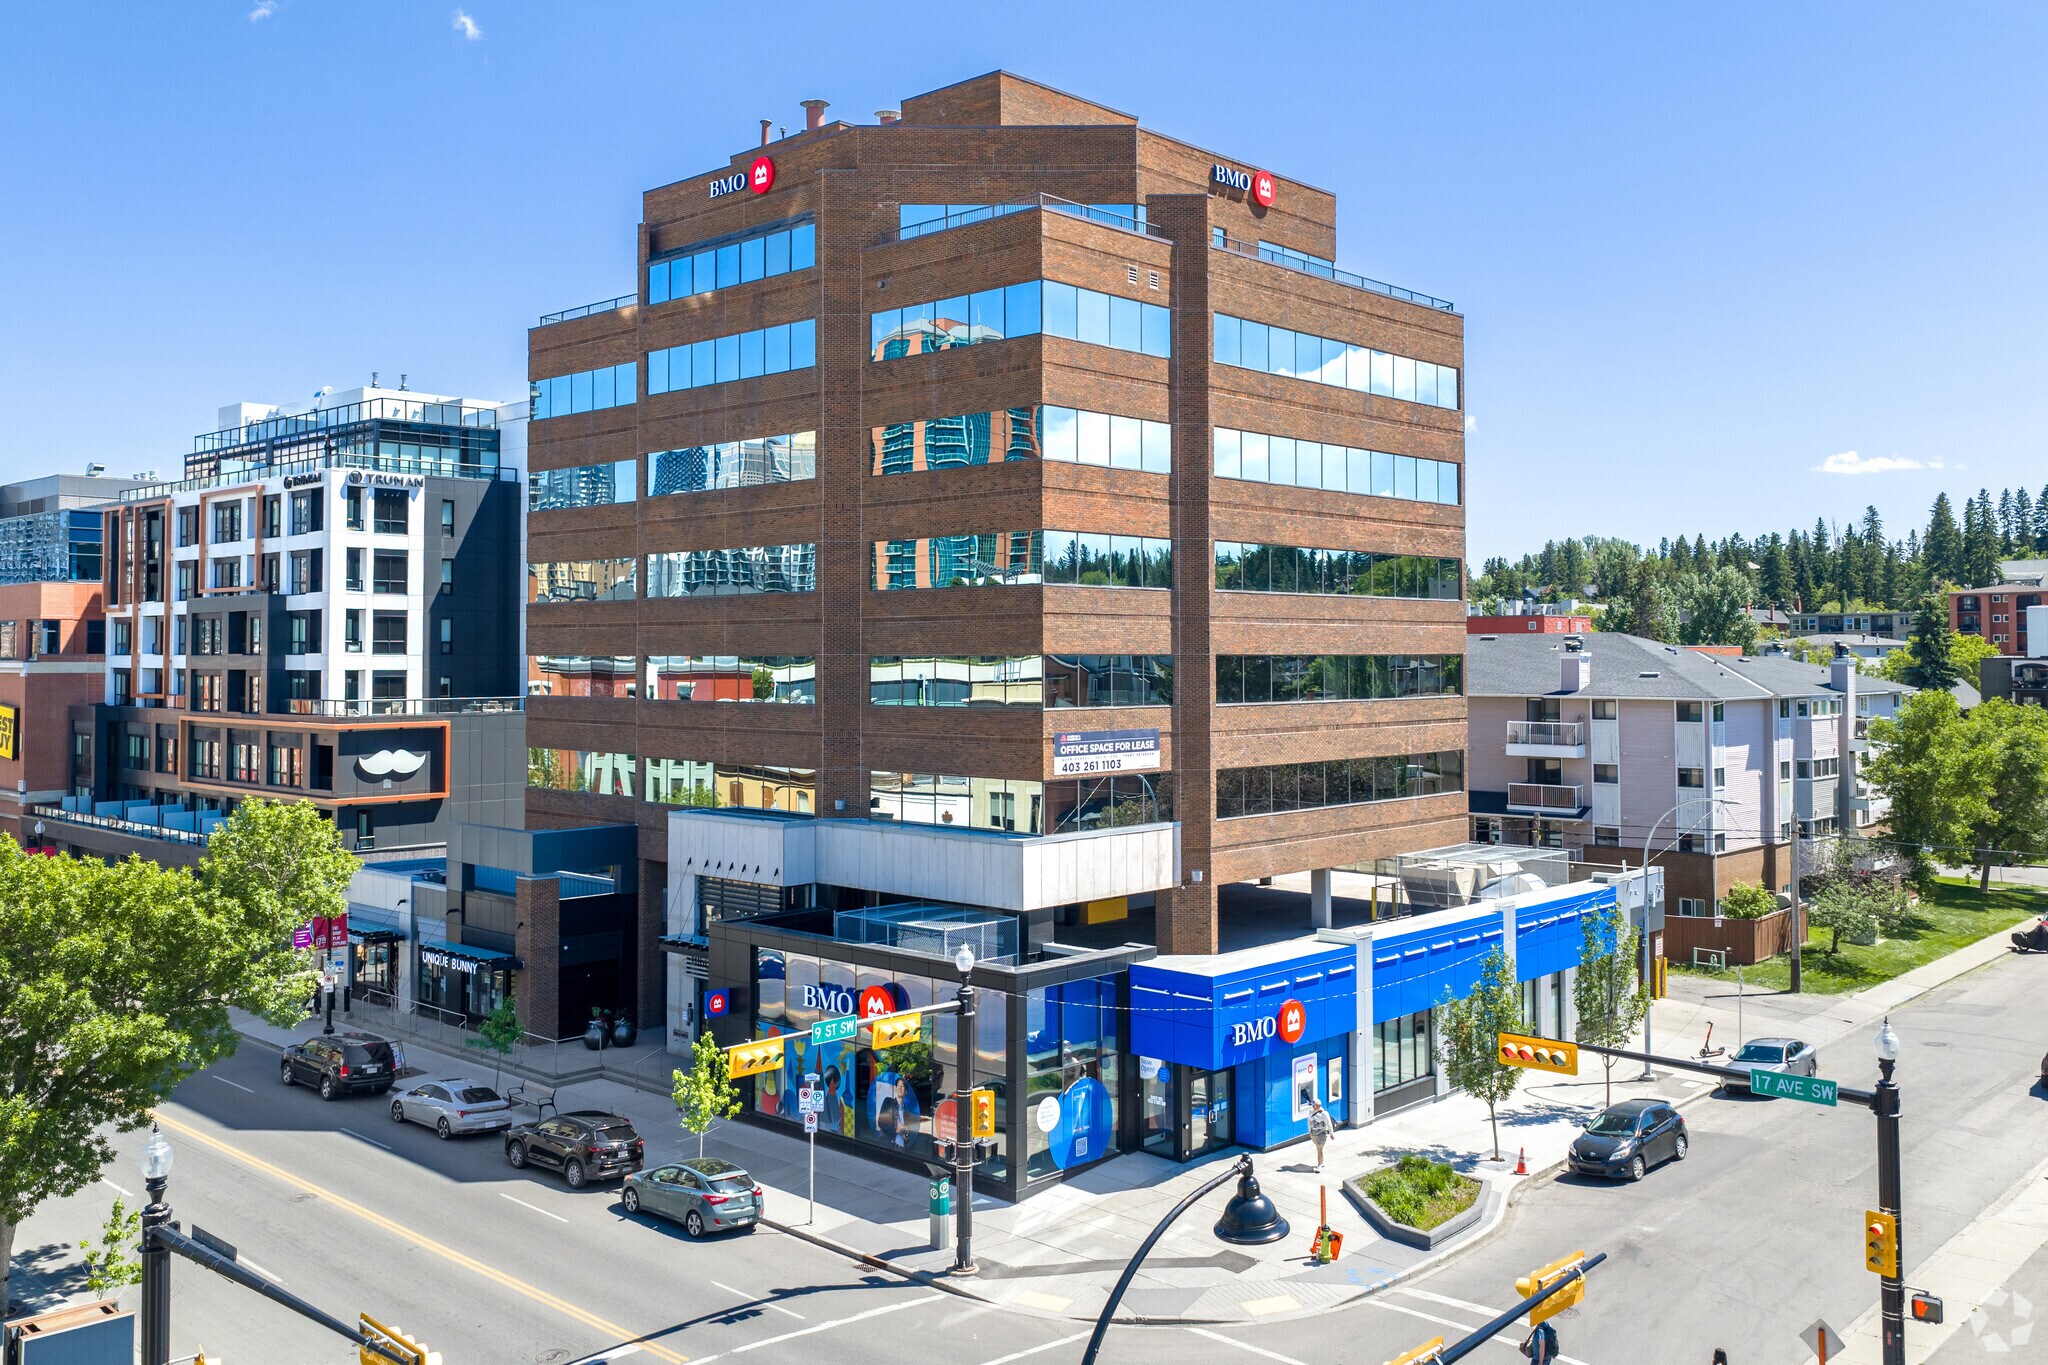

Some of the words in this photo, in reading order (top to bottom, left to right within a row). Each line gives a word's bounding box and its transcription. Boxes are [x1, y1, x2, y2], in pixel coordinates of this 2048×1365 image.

[709, 173, 746, 198] BMO
[1213, 164, 1251, 191] BMO
[366, 473, 424, 488] TRUMAN
[1060, 744, 1089, 755] OFFICE
[1090, 743, 1114, 753] SPACE
[1115, 741, 1131, 751] FOR
[1131, 740, 1155, 750] LEASE
[1062, 762, 1080, 773] 403
[1083, 761, 1099, 771] 261
[1102, 759, 1122, 770] 1103
[422, 951, 449, 968] UNIQUE
[451, 957, 478, 975] BUNNY
[802, 985, 854, 1016] BMO
[814, 1027, 822, 1040] 9
[825, 1023, 837, 1038] ST
[840, 1019, 855, 1034] SW
[1231, 1016, 1277, 1047] BMO
[1140, 1057, 1152, 1066] Now
[1754, 1074, 1771, 1090] 17
[1776, 1078, 1804, 1096] AVE
[1811, 1083, 1834, 1101] SW
